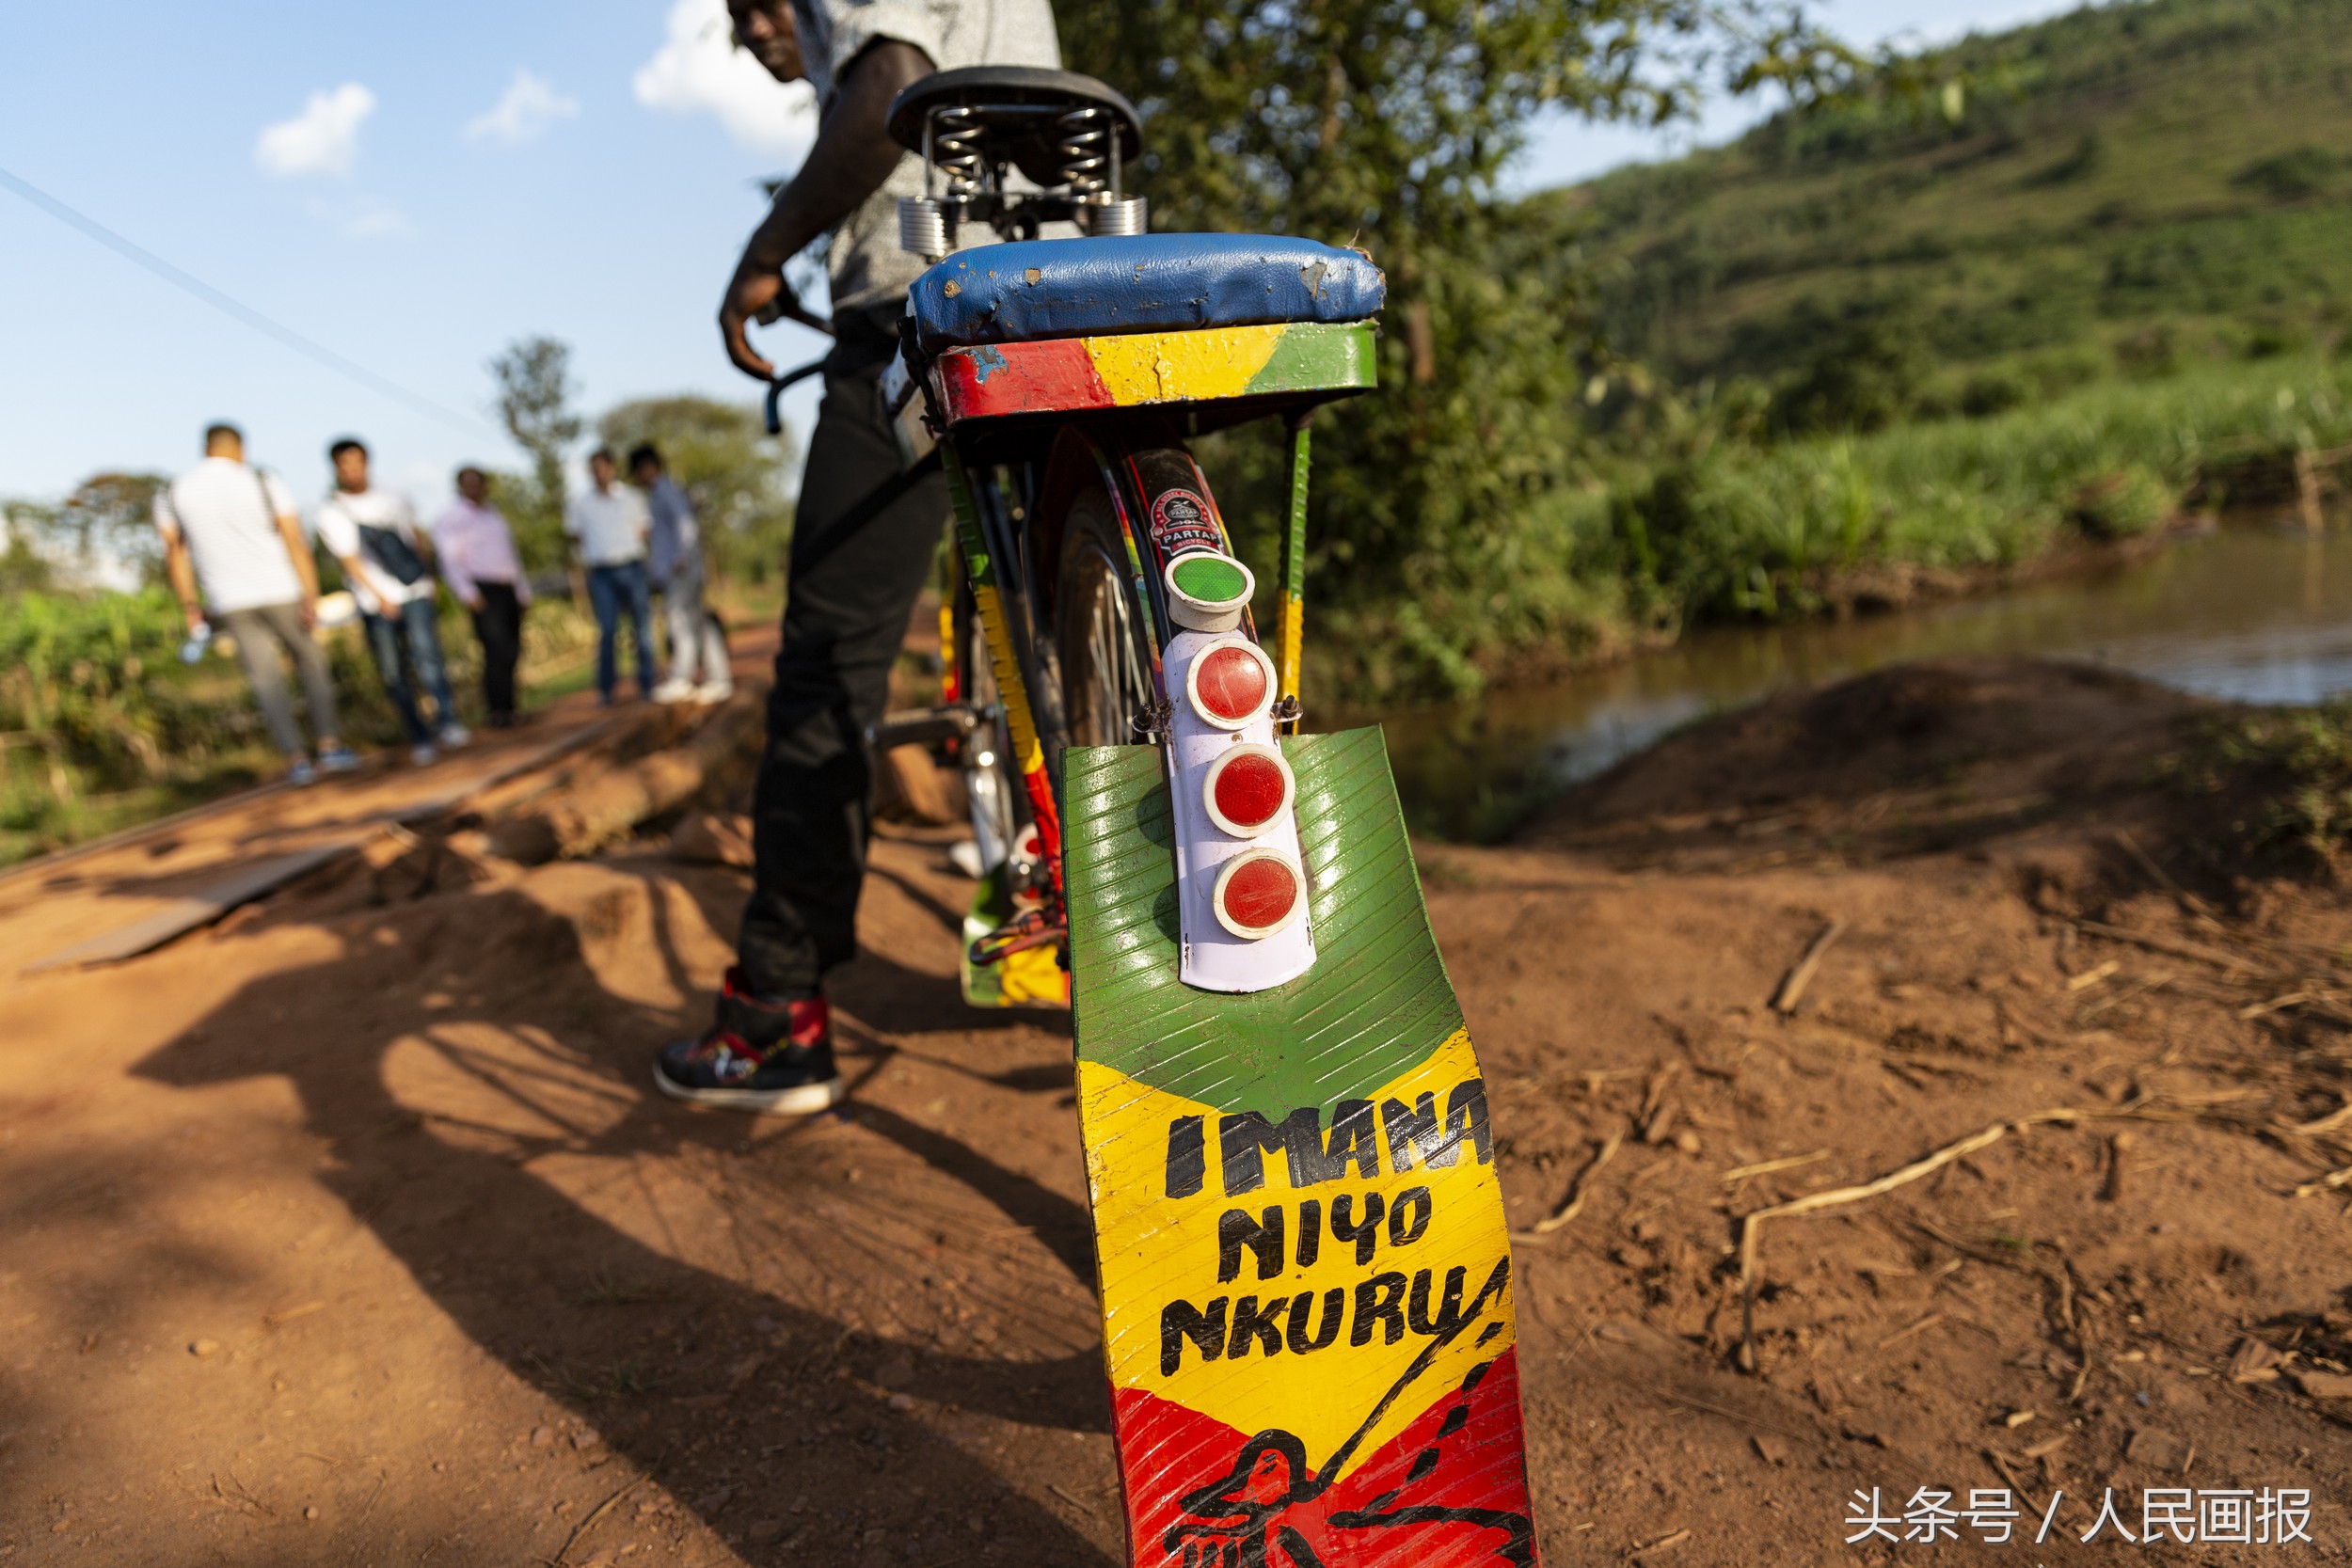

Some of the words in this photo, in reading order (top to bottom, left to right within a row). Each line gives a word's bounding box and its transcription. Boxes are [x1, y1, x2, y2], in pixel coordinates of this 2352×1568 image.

[1163, 530, 1217, 544] PARTAP
[1177, 538, 1212, 547] BICYCLE
[1216, 650, 1242, 662] NILE
[1165, 1078, 1494, 1199] IMANA
[1217, 1186, 1433, 1283] NIYO
[1160, 1265, 1467, 1377] NKURU
